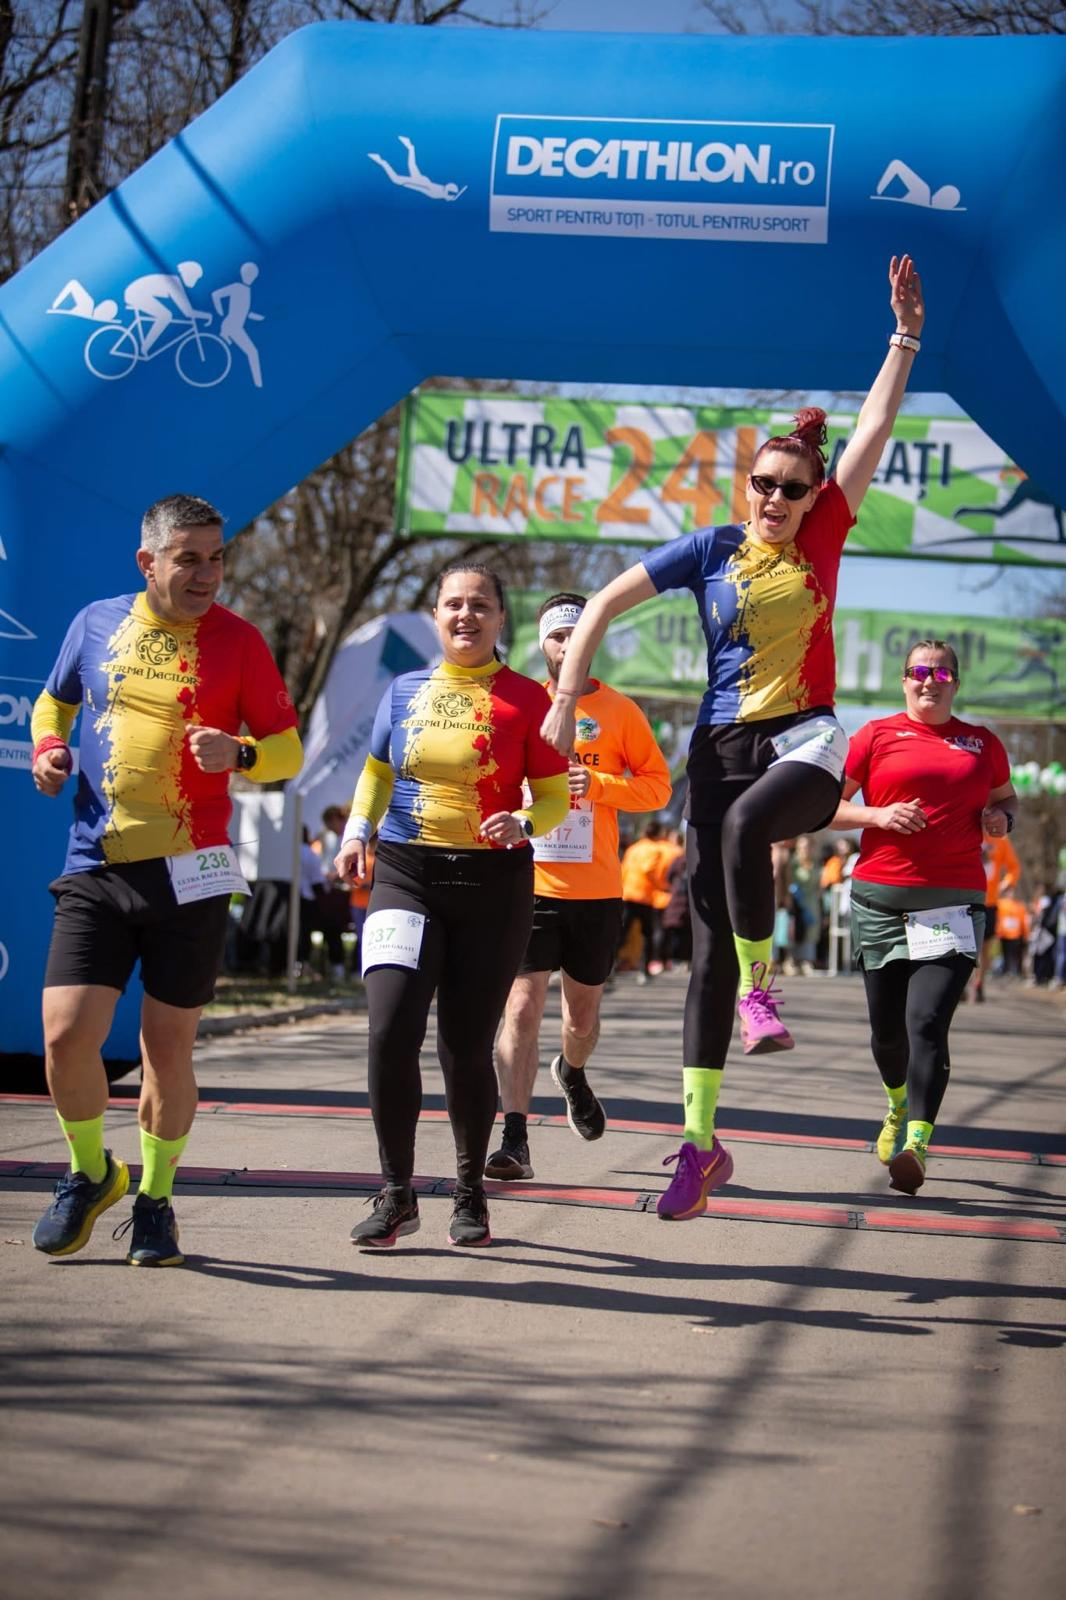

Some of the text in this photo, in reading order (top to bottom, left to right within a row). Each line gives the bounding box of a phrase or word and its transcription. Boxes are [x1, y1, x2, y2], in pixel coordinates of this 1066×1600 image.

[506, 136, 816, 186] DECATHLON.ro
[507, 207, 553, 222] SPORT
[555, 209, 612, 225] PENTRU
[656, 214, 700, 229] TOTUL
[702, 215, 759, 231] PENTRU
[762, 217, 810, 233] SPORT
[446, 420, 587, 469] ULTRA
[471, 472, 585, 522] RACE
[196, 852, 230, 871] 238
[932, 922, 951, 936] 85
